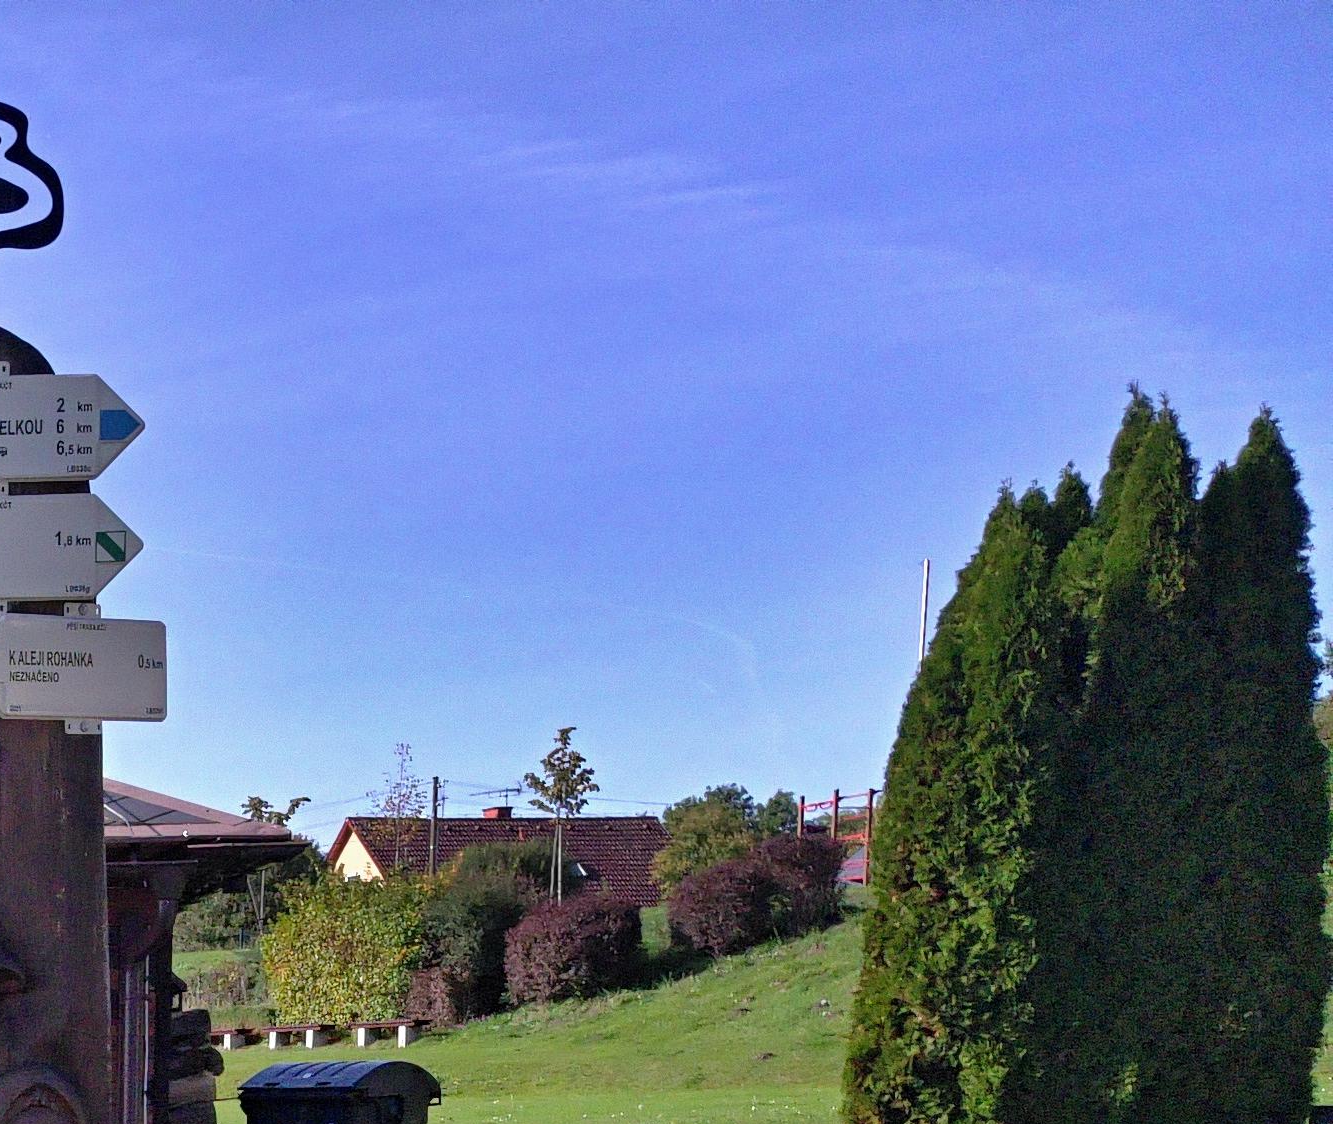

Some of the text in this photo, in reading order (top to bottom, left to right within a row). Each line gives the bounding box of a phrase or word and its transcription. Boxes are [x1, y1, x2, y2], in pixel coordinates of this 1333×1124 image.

[57, 398, 65, 412] 2
[77, 402, 93, 412] km
[57, 419, 65, 434] 6
[77, 423, 92, 433] km
[57, 440, 74, 456] 6,5
[77, 444, 92, 455] km
[55, 531, 73, 547] 1,8
[76, 535, 91, 546] km
[9, 650, 163, 669] K ALEJI ROHANKA 0,5 km
[9, 670, 59, 683] NEZNAČENO
